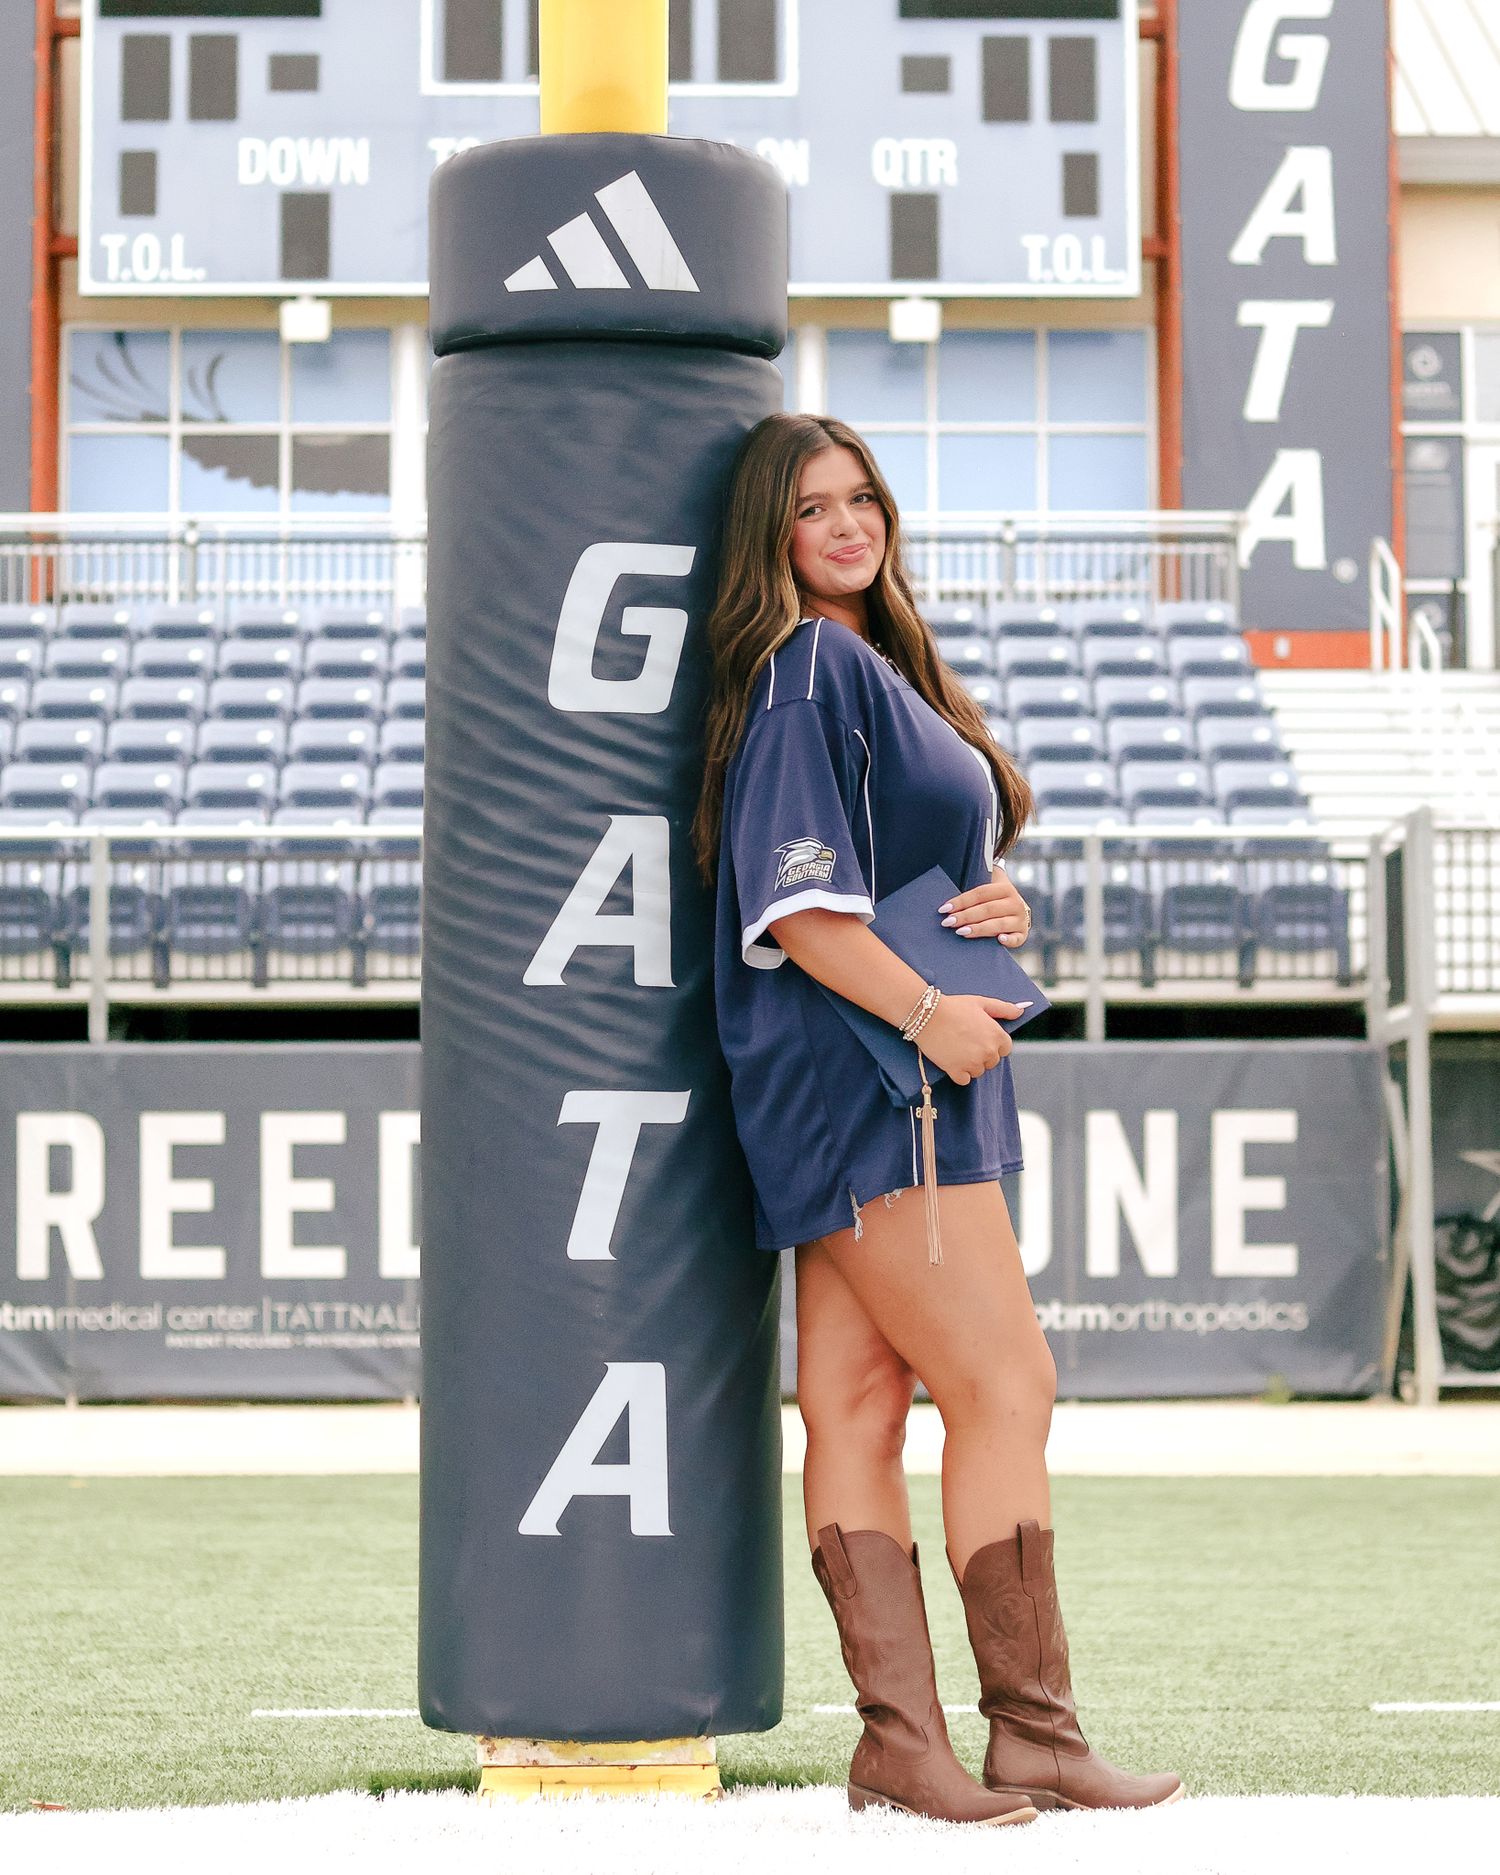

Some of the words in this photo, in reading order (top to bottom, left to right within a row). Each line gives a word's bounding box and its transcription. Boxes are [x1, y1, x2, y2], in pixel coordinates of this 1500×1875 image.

[237, 137, 370, 185] DOWN
[872, 137, 958, 187] QTR
[100, 233, 207, 281] T.O.L.
[1021, 233, 1127, 281] T.O.L.
[1228, 0, 1338, 571] GATA
[785, 869, 830, 884] SOUTHERN
[787, 861, 831, 876] GEORGIA
[518, 542, 697, 1536] GATA
[166, 1304, 258, 1331] center
[272, 1302, 420, 1331] TATTNAL
